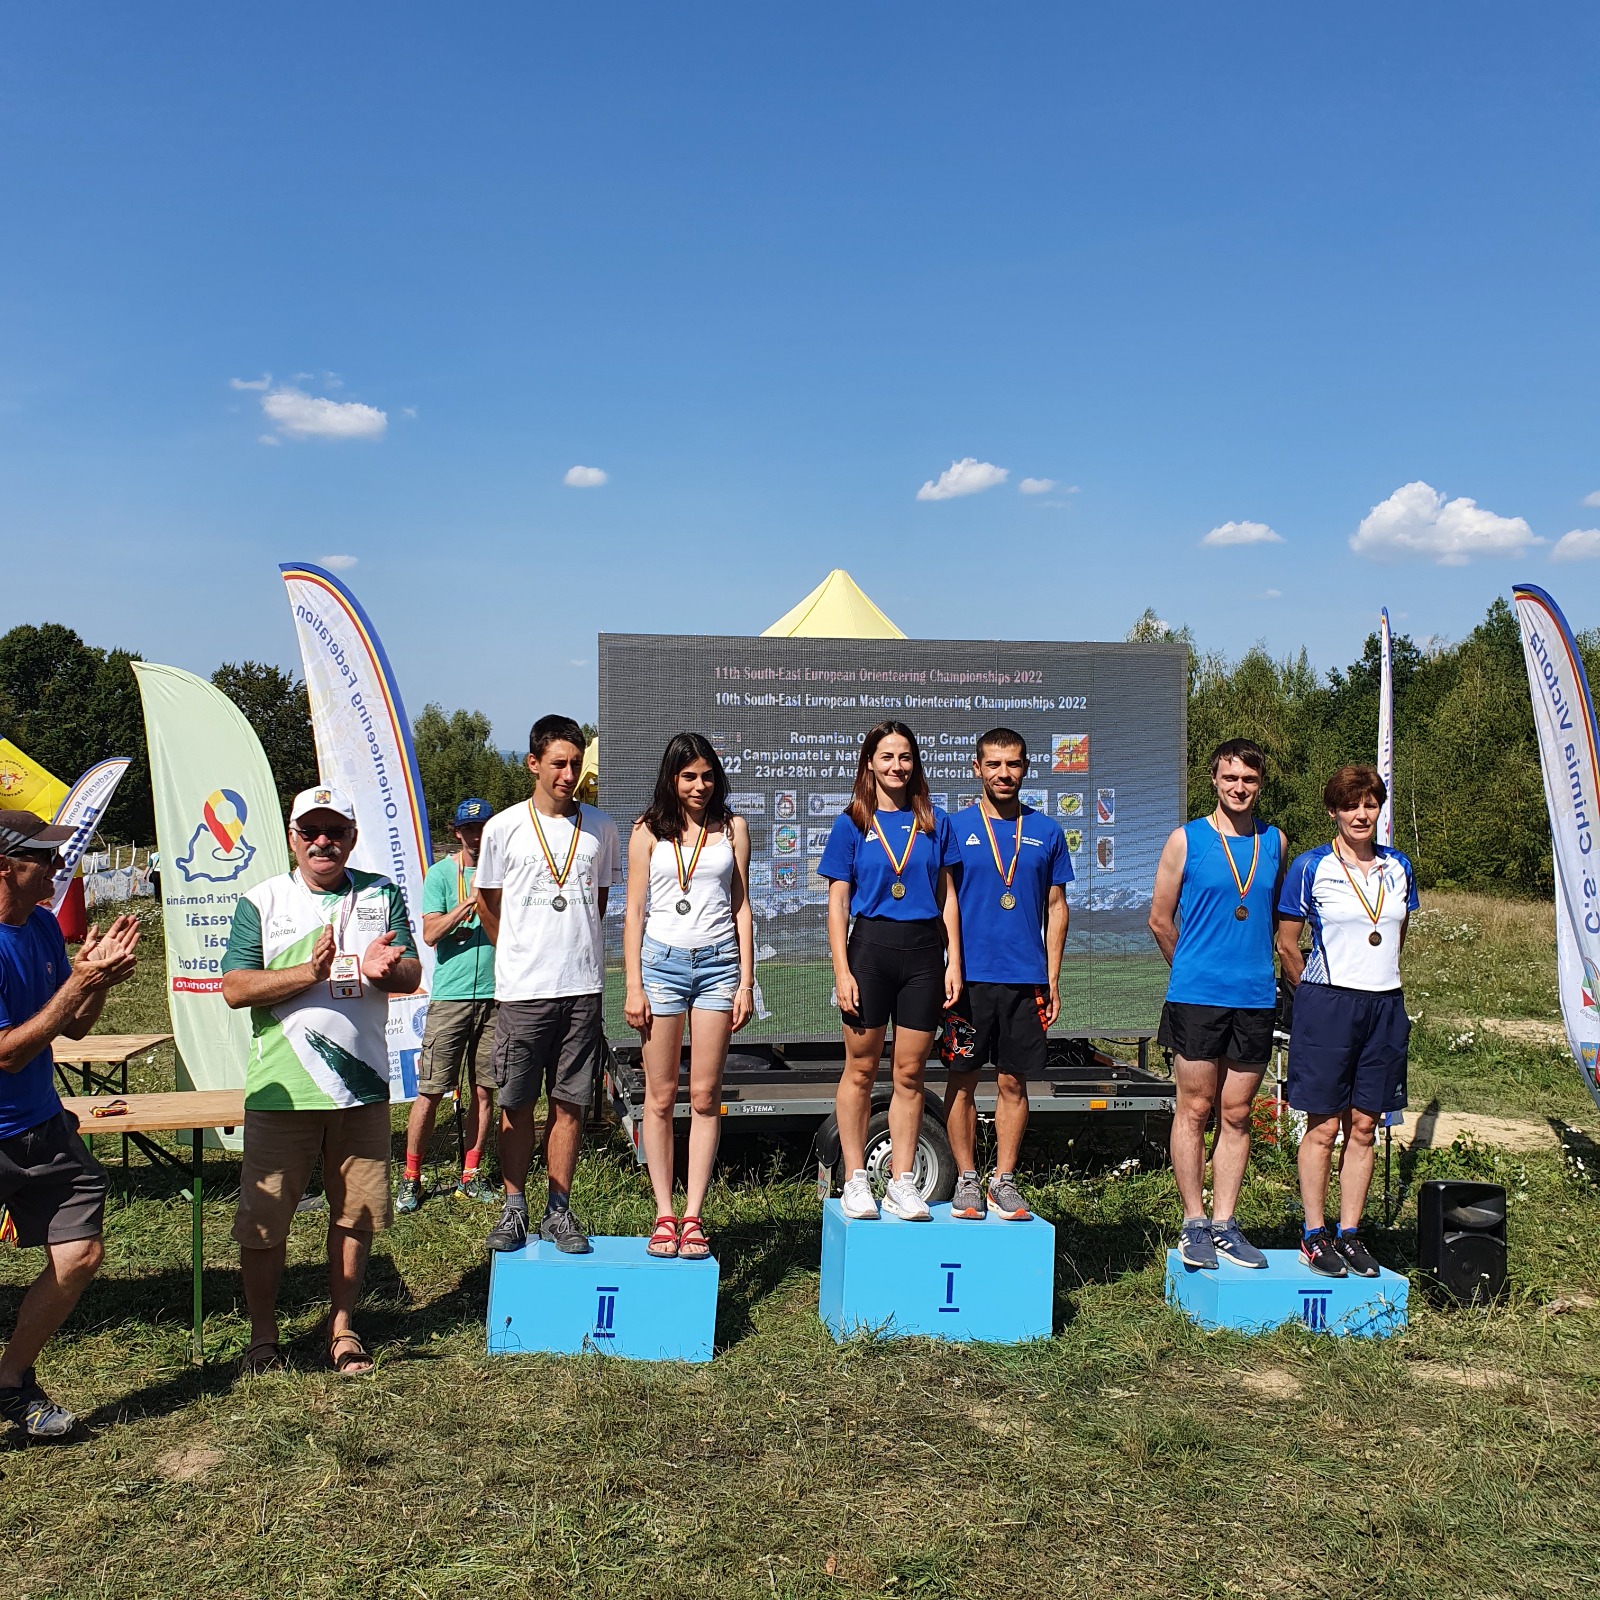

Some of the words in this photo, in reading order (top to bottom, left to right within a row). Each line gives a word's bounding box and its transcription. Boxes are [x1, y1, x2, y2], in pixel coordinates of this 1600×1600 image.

[714, 666, 740, 680] 11th
[744, 666, 801, 681] South-East
[804, 667, 856, 684] European
[859, 668, 926, 685] Orienteering
[929, 669, 1011, 685] Championships
[1013, 670, 1043, 684] 2022
[715, 692, 741, 706] 10th
[744, 692, 801, 707] South-East
[805, 693, 856, 710] European
[858, 693, 901, 708] Masters
[905, 694, 972, 711] Orienteering
[974, 695, 1055, 712] Championships
[1058, 696, 1087, 710] 2022
[790, 731, 853, 745] Romanian
[939, 733, 977, 746] Grand
[742, 748, 831, 764] Campionatele
[754, 765, 817, 779] 23rd-28th
[820, 766, 834, 778] of
[923, 766, 974, 779] Victoria
[358, 921, 385, 932] 2022
